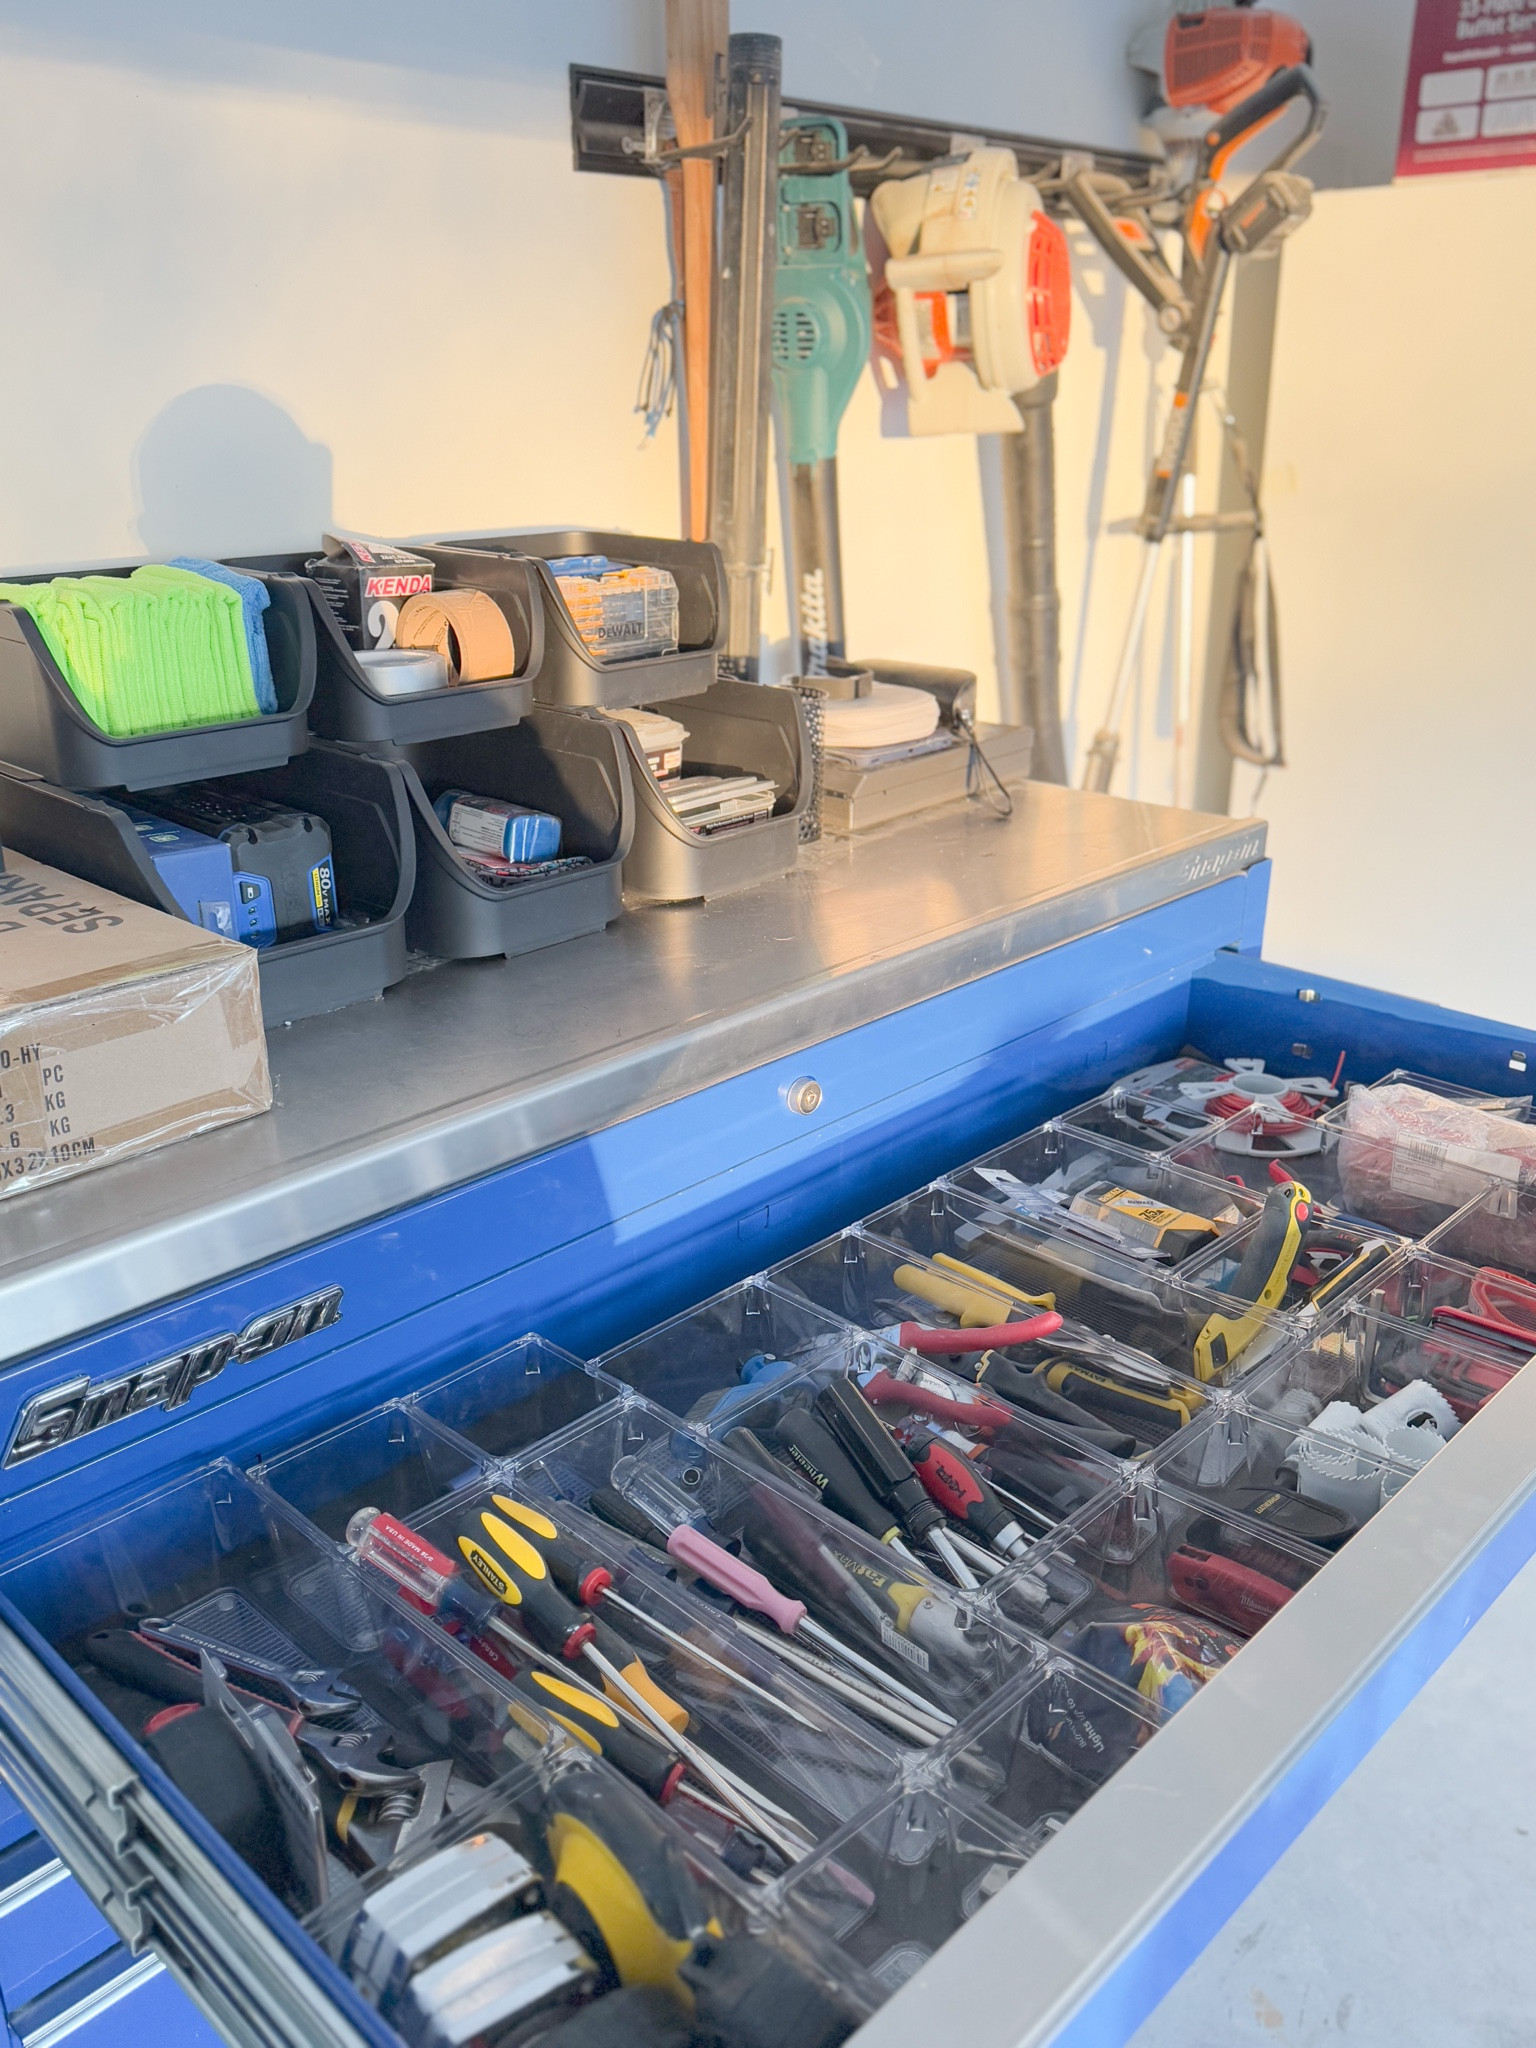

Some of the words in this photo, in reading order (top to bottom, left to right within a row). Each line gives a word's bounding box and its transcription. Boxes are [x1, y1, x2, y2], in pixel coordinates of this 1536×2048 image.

[365, 574, 432, 597] KENDA
[42, 1065, 64, 1087] PC
[45, 1091, 66, 1112] KG
[50, 1117, 71, 1138] KG
[0, 1137, 95, 1181] X32X10CM
[3, 1283, 344, 1469] Snap-on
[788, 1445, 829, 1490] Wheeler
[385, 1525, 399, 1536] USA
[397, 1533, 405, 1542] IN
[404, 1539, 421, 1553] MADE
[472, 1552, 506, 1592] STANLEY
[1083, 1721, 1105, 1754] Lights
